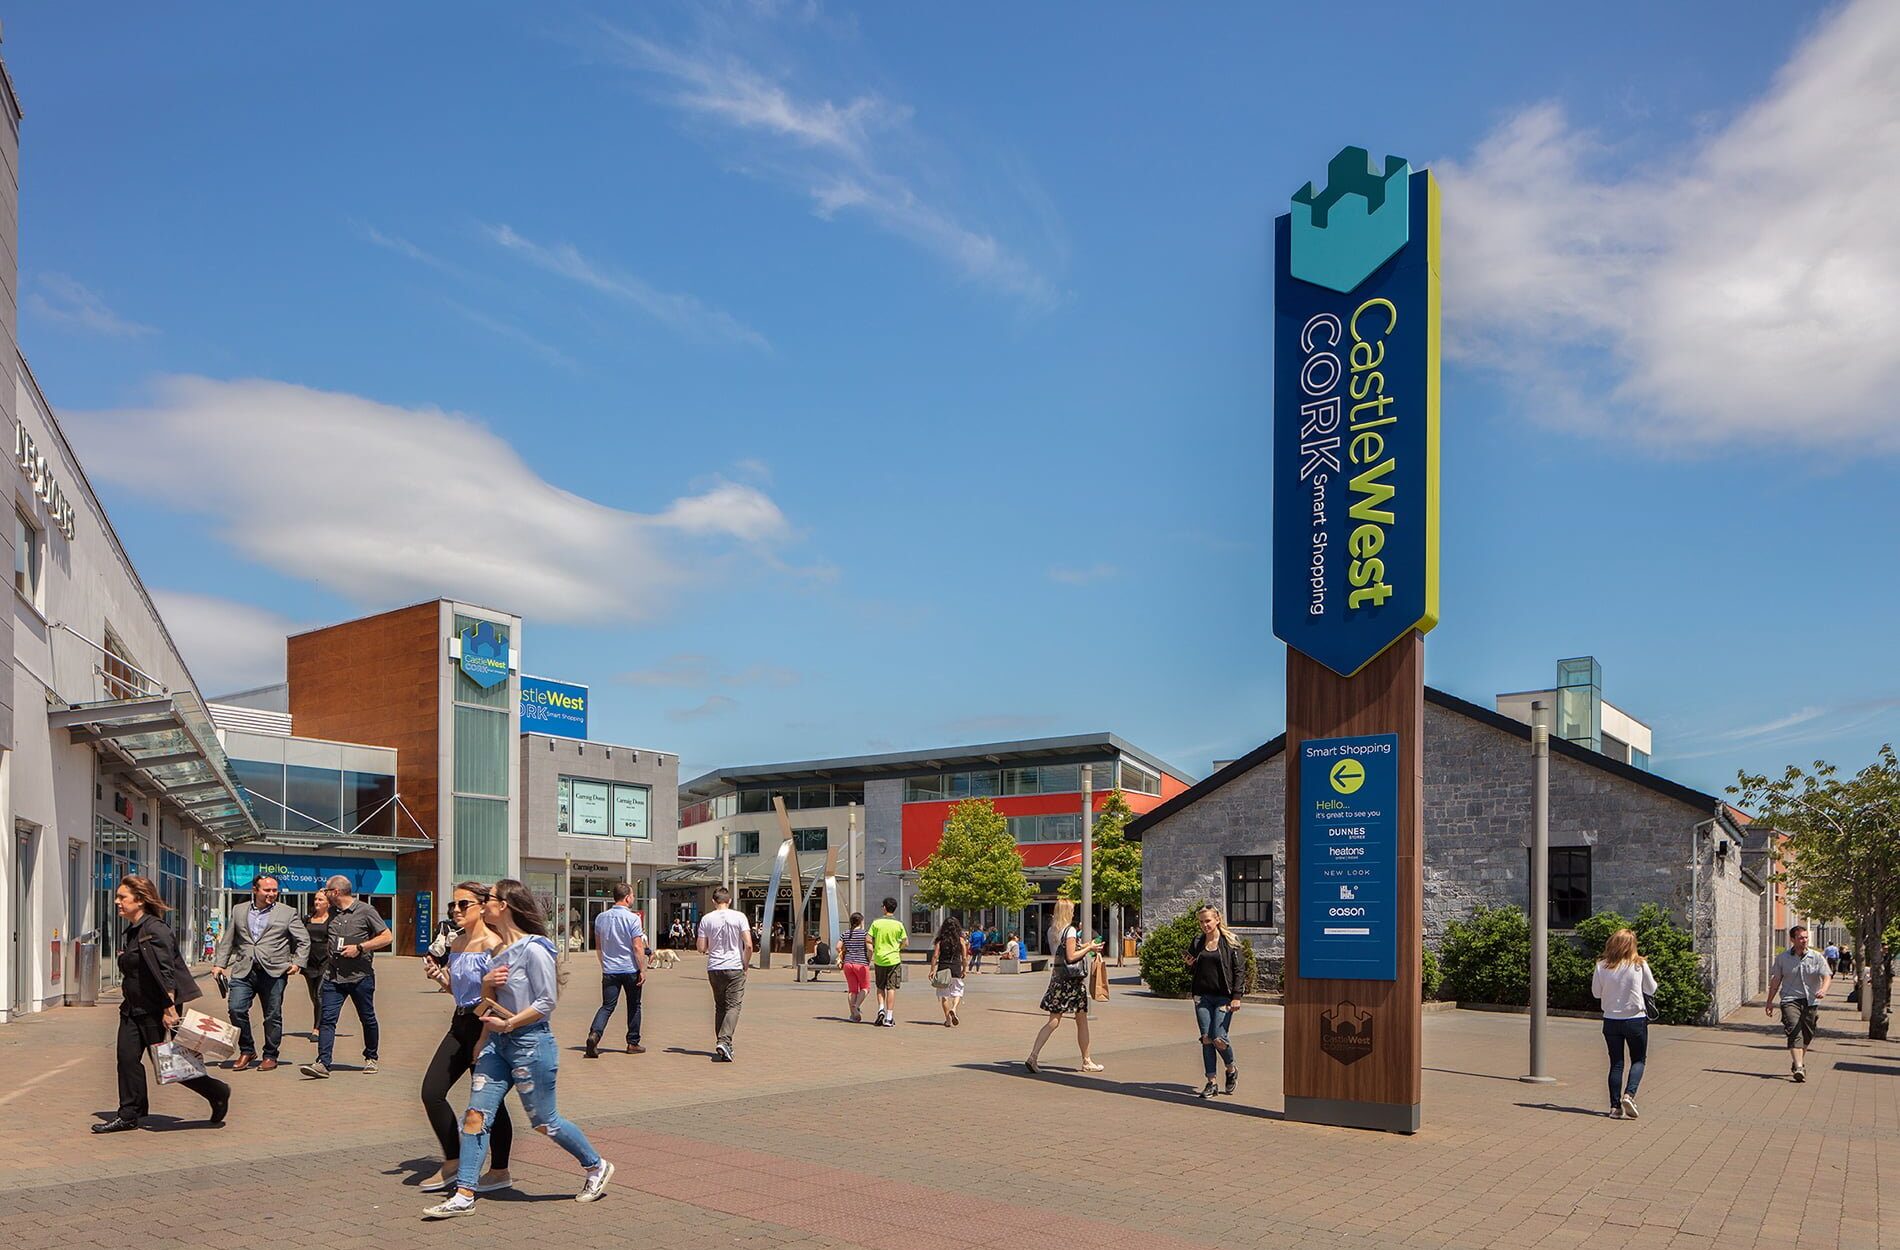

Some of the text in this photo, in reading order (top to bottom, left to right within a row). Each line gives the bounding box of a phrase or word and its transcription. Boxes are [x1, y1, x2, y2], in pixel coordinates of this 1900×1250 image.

[15, 418, 39, 483] NES
[1349, 297, 1398, 609] CastleWest
[1300, 312, 1343, 615] CORK Smart Shopping
[464, 654, 506, 669] CastleWest
[520, 687, 584, 711] stleWest
[519, 703, 548, 721] ORK
[562, 713, 584, 724] Shopping
[1306, 743, 1391, 758] Smart Shopping
[1316, 799, 1351, 810] Hello...
[1325, 811, 1345, 820] great
[1345, 811, 1354, 819] to
[1354, 811, 1367, 819] see
[1367, 810, 1381, 818] you
[1328, 827, 1366, 837] DUNNES
[1329, 846, 1365, 856] heatons
[259, 863, 295, 875] Hello...
[290, 874, 299, 882] to
[312, 875, 327, 884] you
[747, 888, 770, 898] NOS
[1329, 907, 1365, 917] eason
[1322, 1034, 1370, 1045] CastleWest
